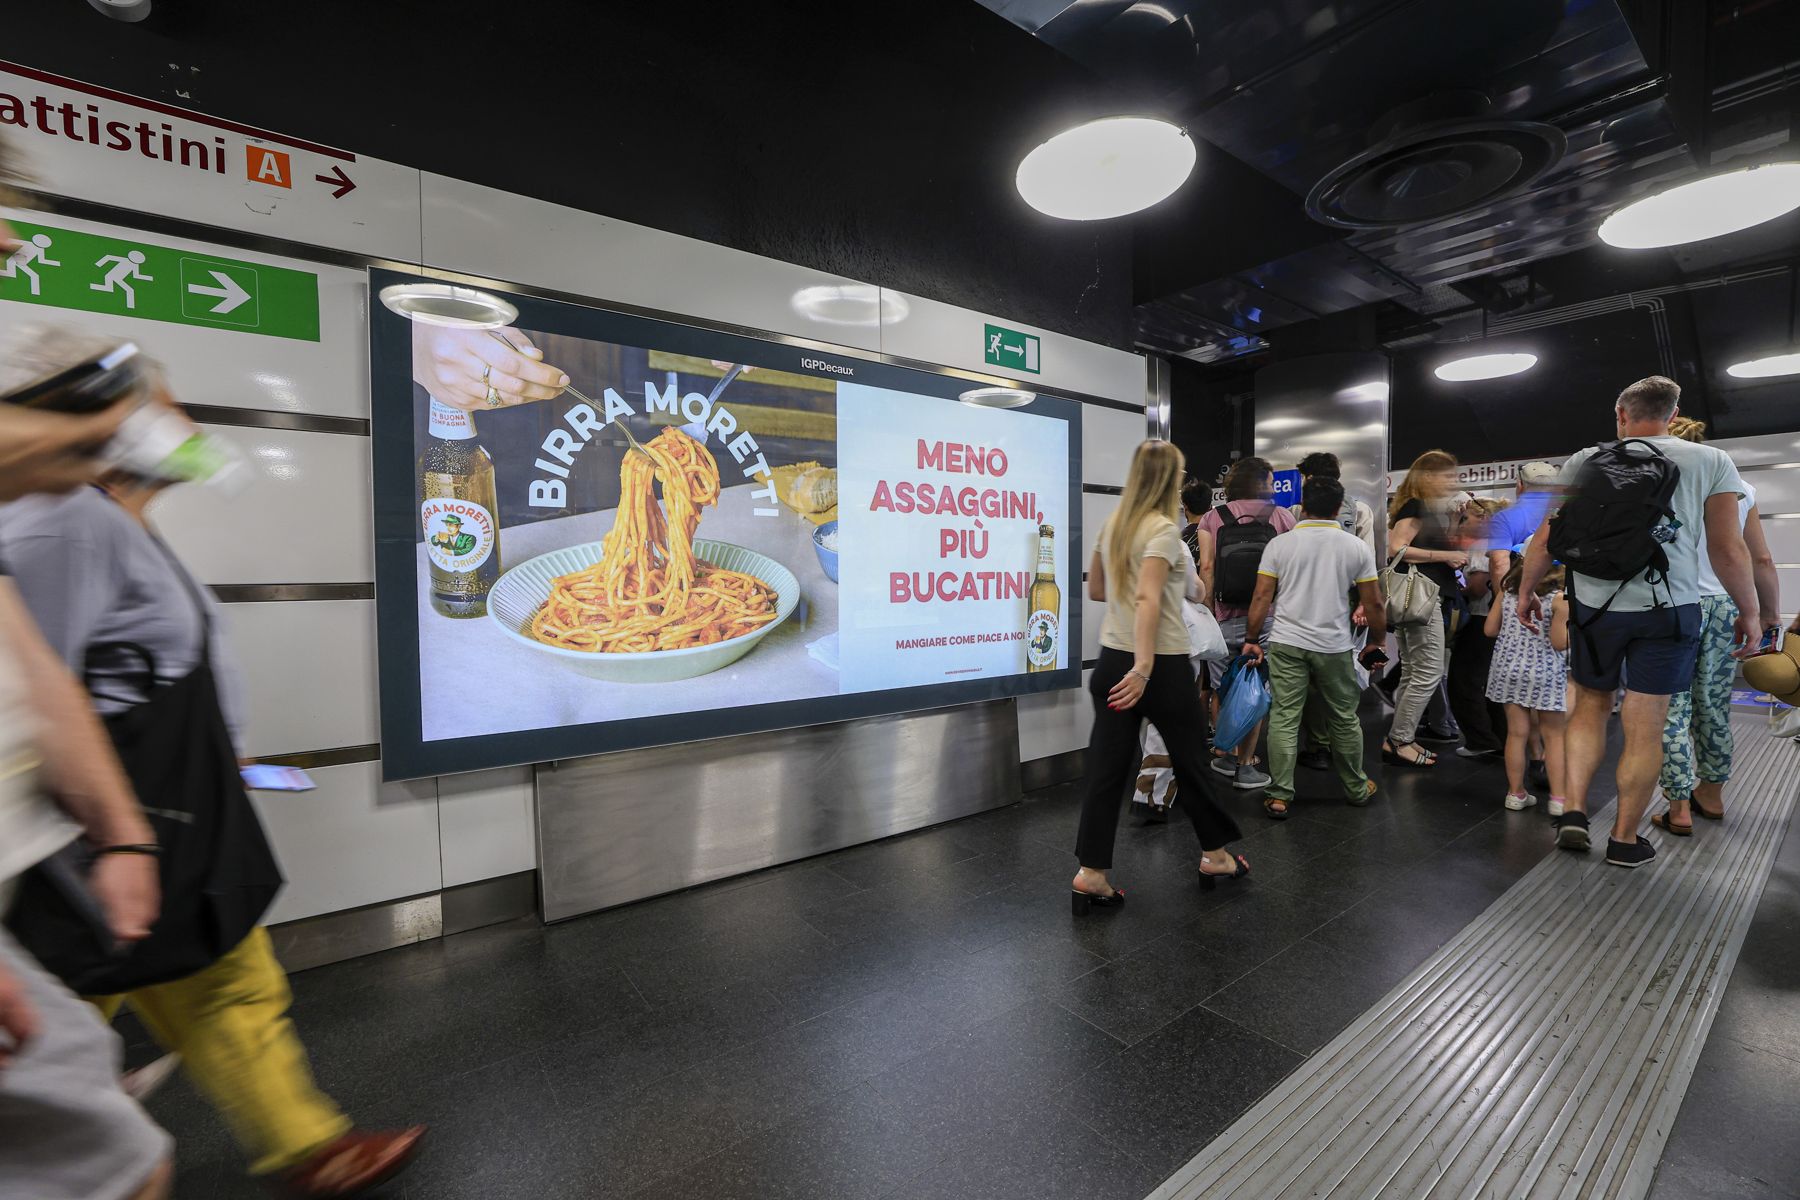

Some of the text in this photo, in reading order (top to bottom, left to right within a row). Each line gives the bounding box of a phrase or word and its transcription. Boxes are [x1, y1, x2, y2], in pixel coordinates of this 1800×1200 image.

[0, 93, 283, 183] attistini A
[801, 357, 854, 376] IGPDecaux
[439, 413, 465, 421] BUONA
[528, 381, 779, 517] BIRRA MORETTI
[917, 439, 1008, 477] MENO
[1458, 463, 1516, 483] ebibbi
[443, 503, 491, 534] MORETTI
[870, 480, 1044, 525] ASSAGGINI,
[940, 520, 988, 559] PIÙ
[889, 571, 1030, 603] BUCATINI
[896, 631, 1026, 650] MANGIARE COME PIACE A NOI
